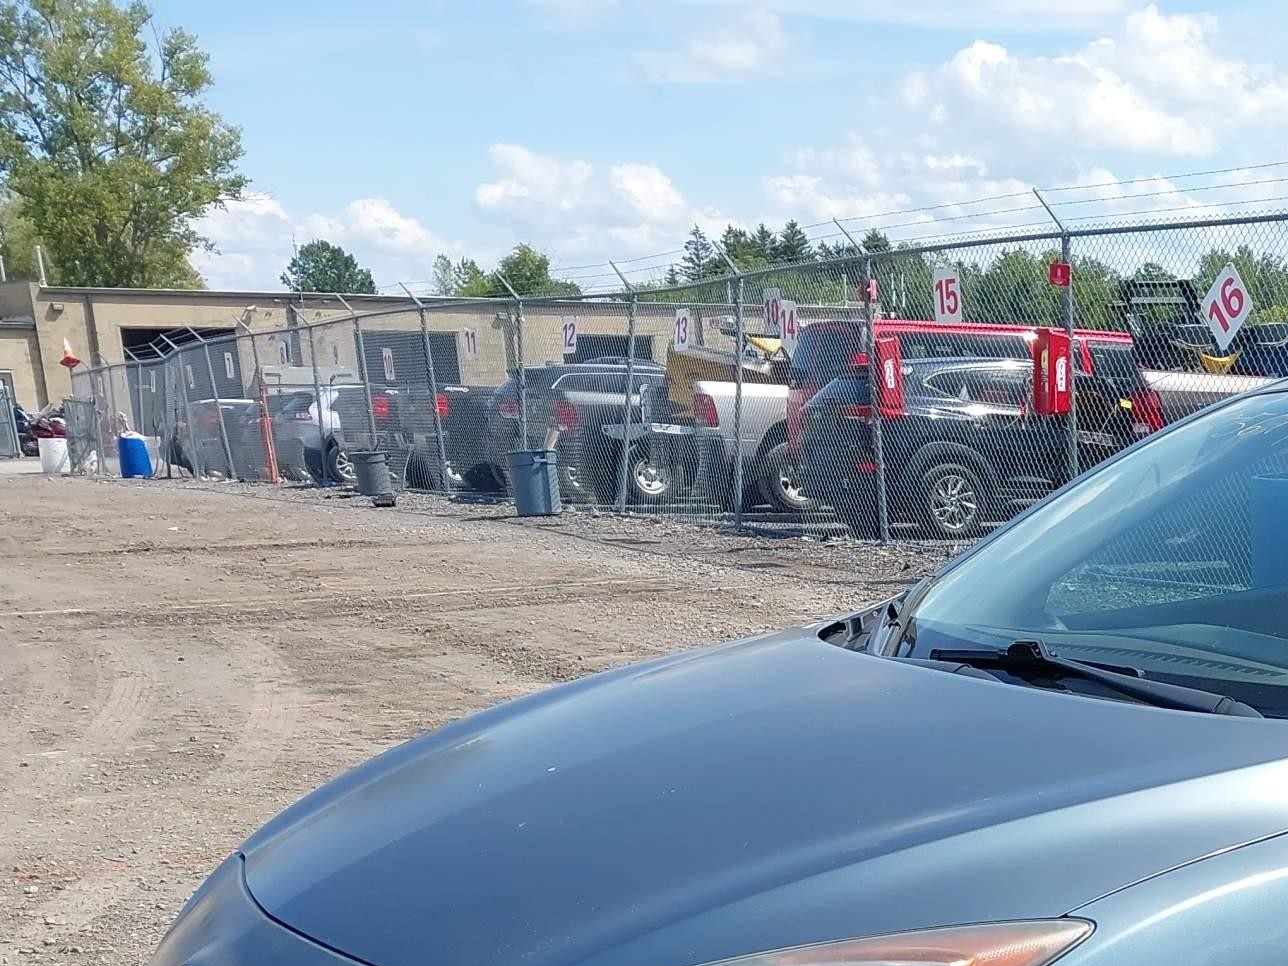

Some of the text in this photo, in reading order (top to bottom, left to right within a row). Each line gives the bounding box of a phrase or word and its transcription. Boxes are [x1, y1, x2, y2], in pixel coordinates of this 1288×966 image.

[935, 278, 959, 315] 15
[1208, 277, 1244, 334] 16
[563, 322, 576, 348] 12
[675, 316, 688, 345] 13
[780, 309, 796, 341] 14
[464, 330, 477, 354] 11
